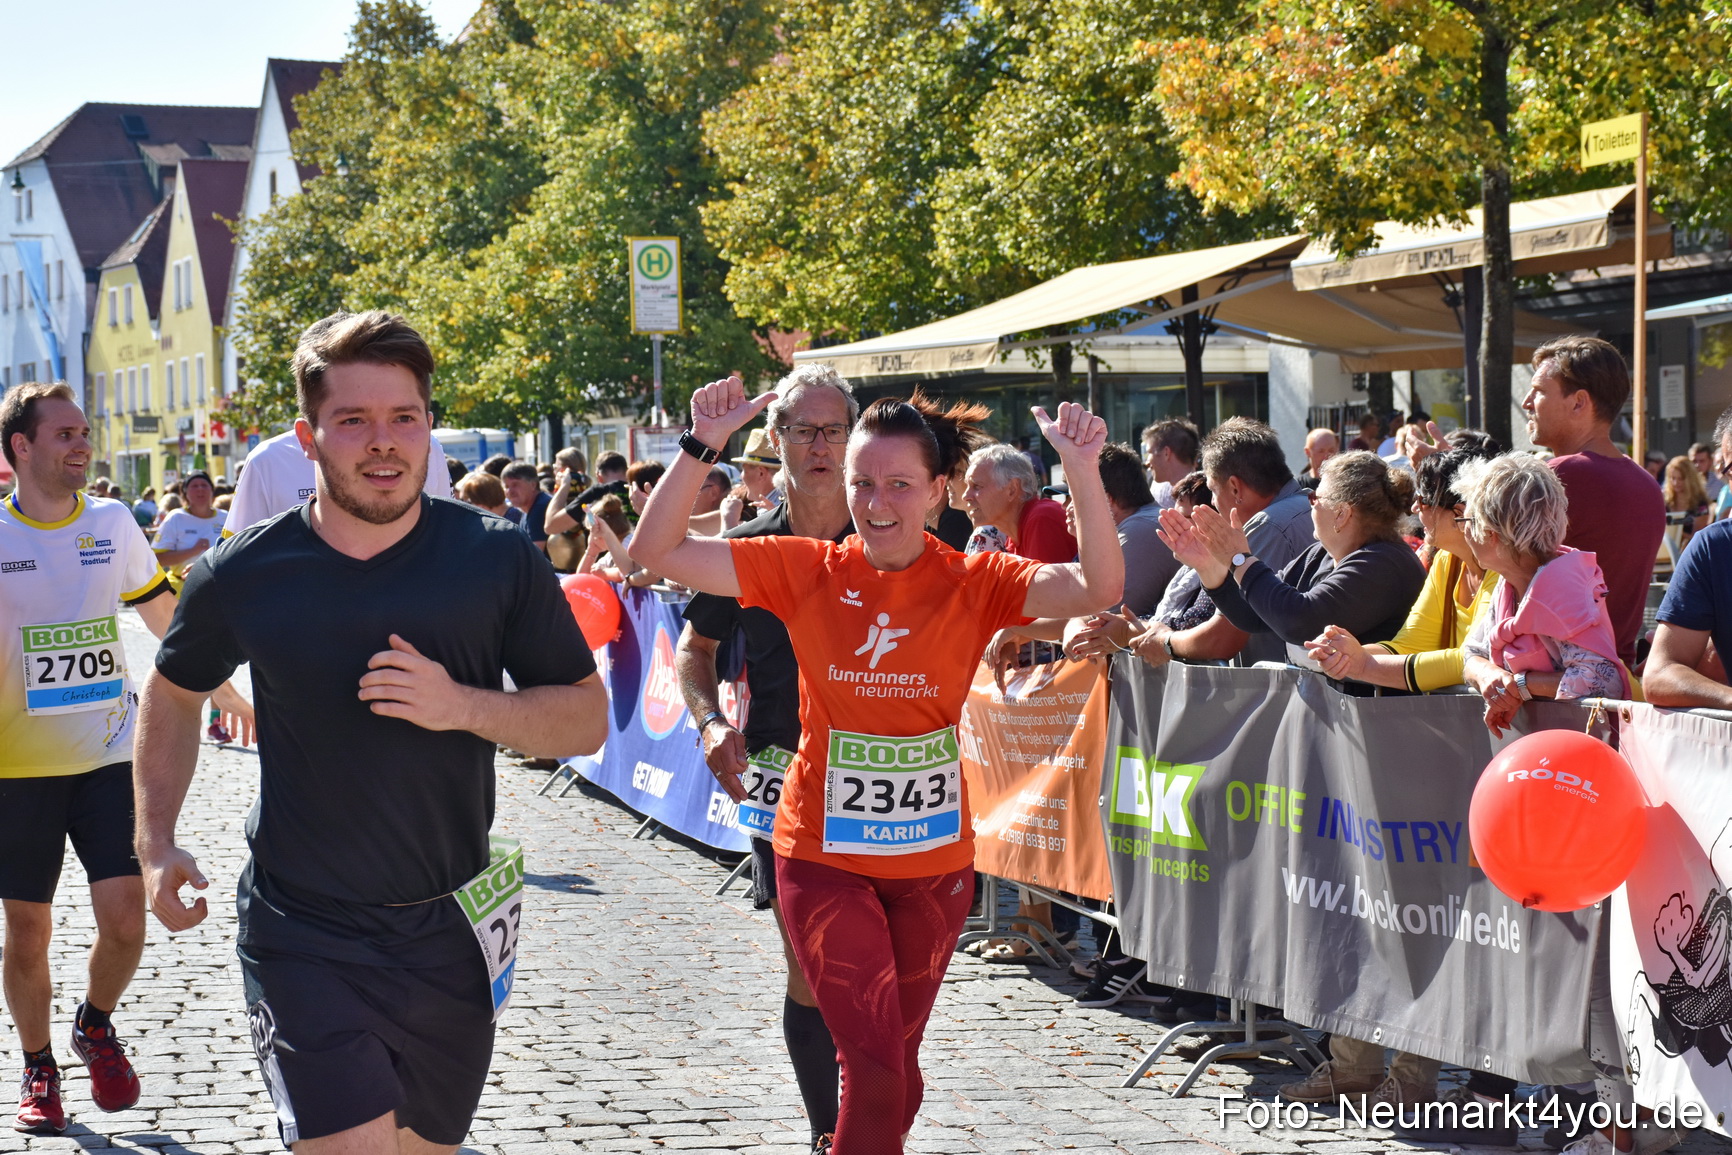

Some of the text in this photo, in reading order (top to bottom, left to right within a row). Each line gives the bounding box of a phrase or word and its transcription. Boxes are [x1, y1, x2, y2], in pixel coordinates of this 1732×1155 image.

[1593, 130, 1638, 153] Toiletten
[647, 253, 663, 273] H
[299, 488, 317, 498] BO
[78, 536, 95, 550] 20
[79, 548, 117, 557] Neumarkter
[1, 560, 36, 569] BOCK
[80, 556, 111, 566] Stadtlauf
[840, 596, 863, 607] erima
[29, 619, 113, 650] BOCK
[36, 648, 115, 684] 2709
[828, 664, 926, 685] funrunners
[61, 686, 111, 702] Christoph
[855, 684, 940, 699] neumarkt
[1007, 711, 1047, 730] Konzeption
[1047, 711, 1061, 726] und
[1019, 732, 1051, 749] Projekte
[756, 746, 793, 770] BO
[838, 734, 951, 768] BOCK
[632, 760, 652, 794] GET
[1507, 759, 1599, 797] RÖDL
[748, 772, 784, 806] 26
[842, 773, 946, 814] 2343
[1553, 784, 1597, 804] energie
[1049, 796, 1068, 811] uns:
[863, 822, 929, 842] KARIN
[1006, 828, 1025, 845] 09181
[1025, 831, 1047, 850] 8833
[1048, 836, 1067, 852] 897
[490, 902, 522, 965] 23
